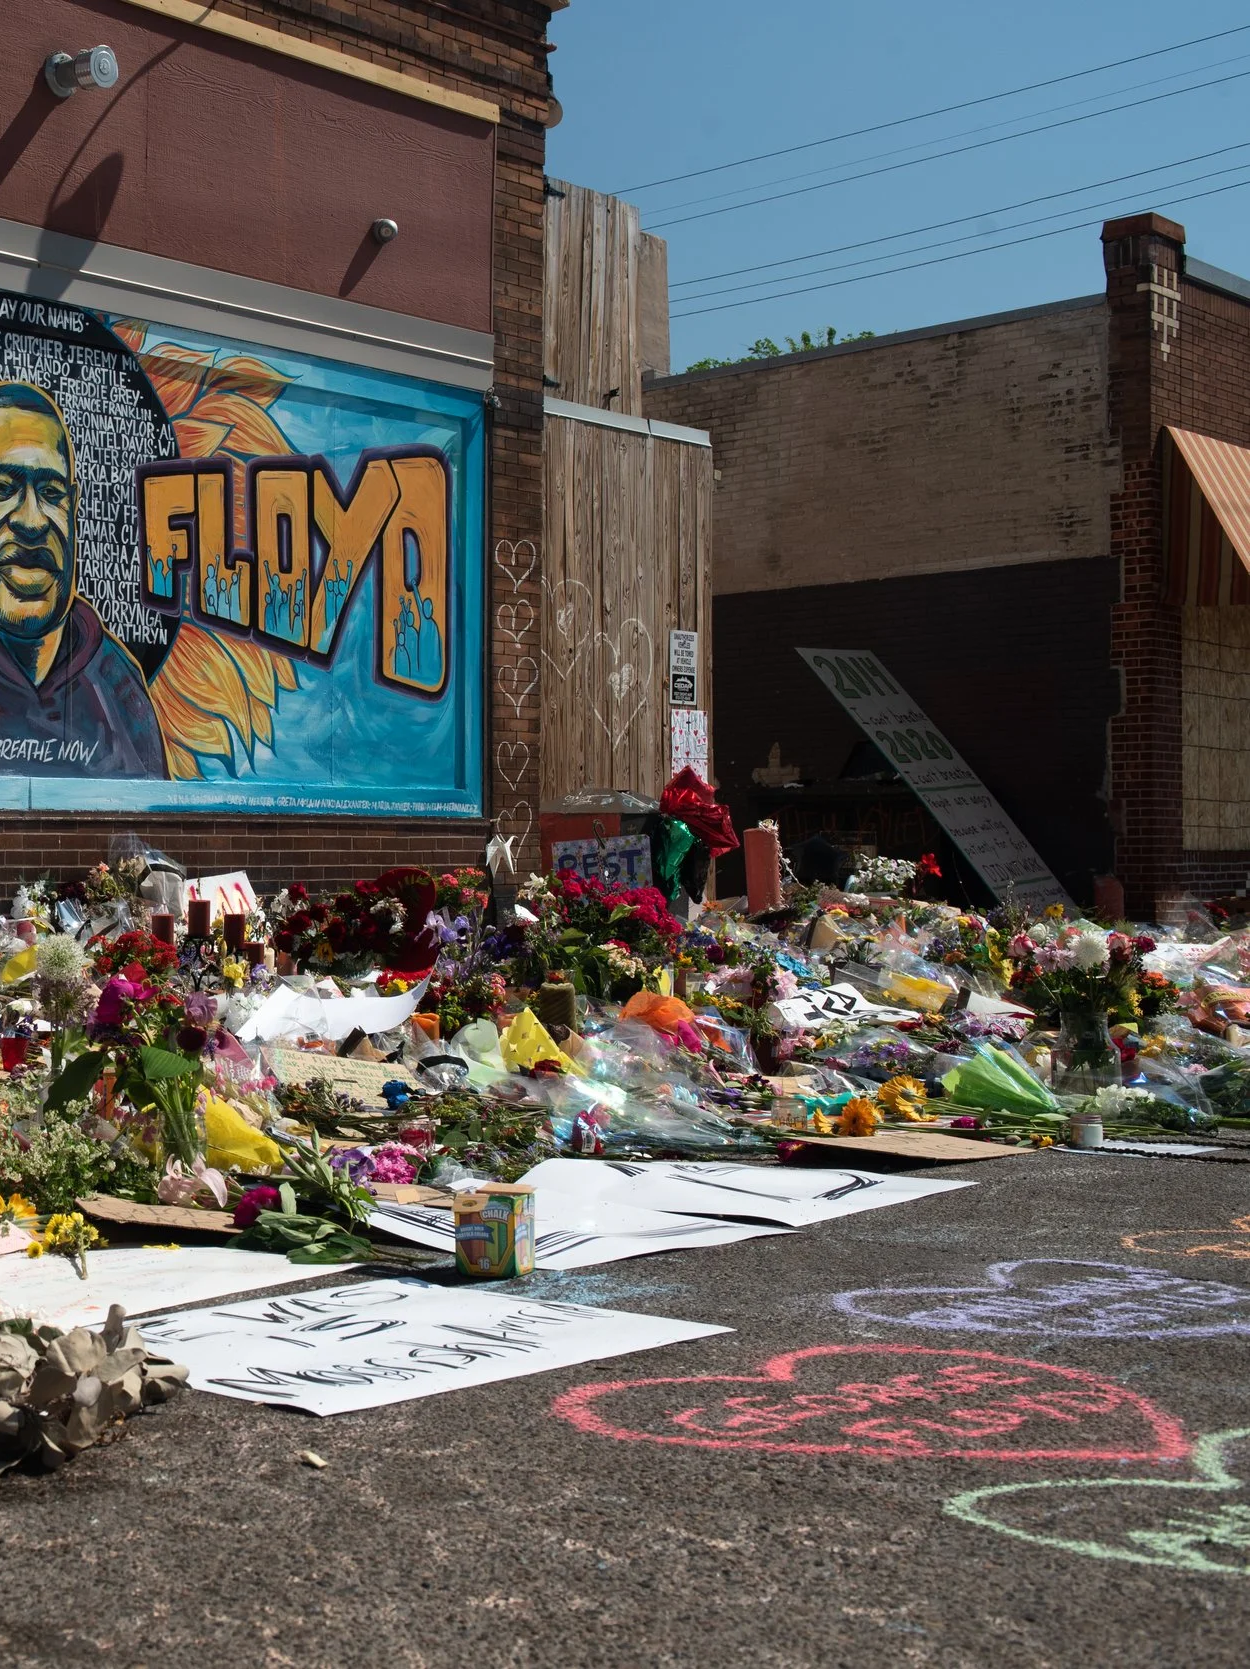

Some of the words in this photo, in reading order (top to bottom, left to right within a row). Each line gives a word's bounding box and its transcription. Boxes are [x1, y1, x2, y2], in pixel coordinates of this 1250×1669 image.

[19, 301, 46, 327] OUR
[48, 307, 85, 333] NAMES
[5, 332, 63, 362] CRUTCHER
[68, 345, 117, 371] JEREMY
[4, 350, 70, 377] PHILANDO
[81, 366, 127, 389] CASTILE
[11, 367, 51, 390] JAMES
[60, 377, 107, 400] FREDDIE
[110, 387, 140, 407] GREY
[52, 390, 101, 414] TERRANCE
[103, 400, 151, 421] FRANKLIN
[63, 408, 115, 432] BREONNA
[115, 417, 156, 440] TAYLOR
[70, 426, 121, 450] SHANTEL
[122, 434, 154, 455] DAVIS
[71, 443, 120, 467] WALTER
[75, 459, 107, 482] REKIA
[78, 498, 120, 521] SHELLY
[77, 519, 118, 543] JAMAR
[77, 540, 128, 564] TANISHA
[77, 577, 115, 601] ALTON
[141, 455, 448, 694] FLOYD
[110, 622, 167, 645] KATHRYN
[55, 738, 100, 767] NOW
[876, 728, 954, 763] 2020
[482, 1209, 509, 1221] CHALK
[478, 1259, 490, 1270] 16
[211, 1286, 408, 1324] WAS
